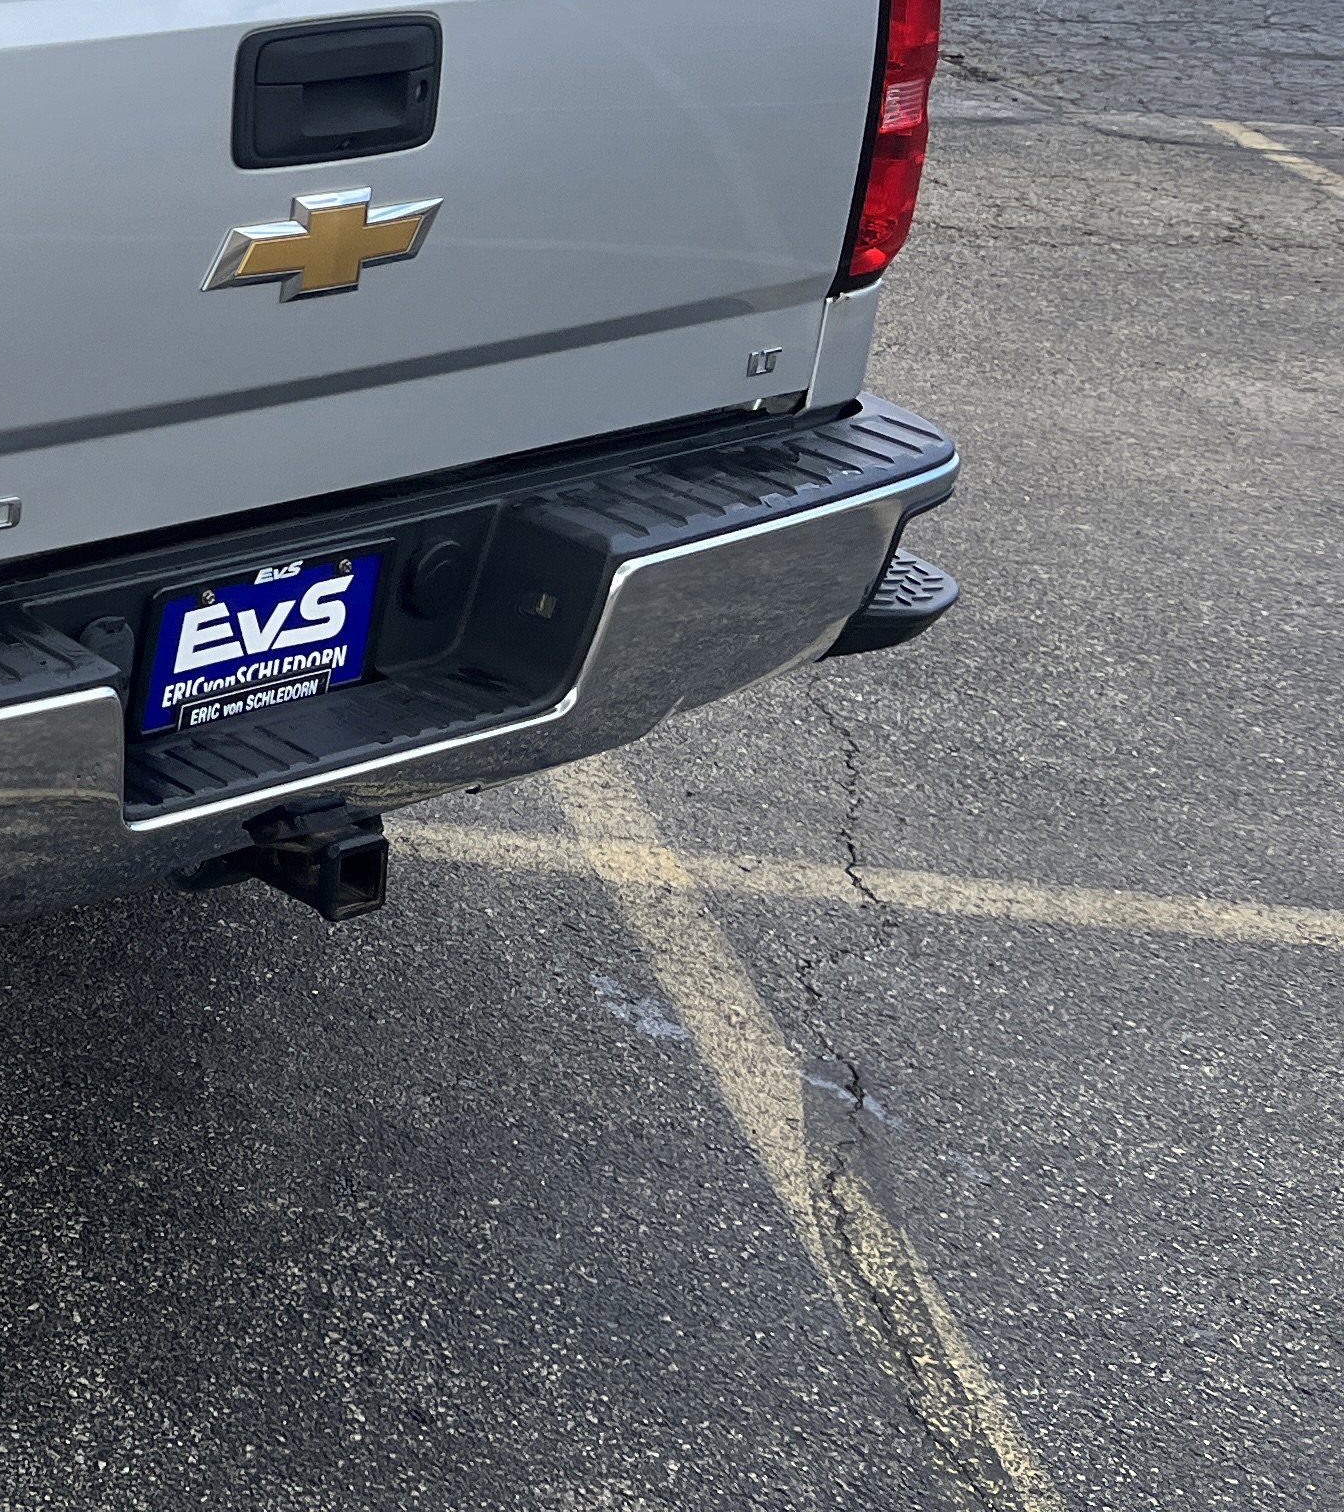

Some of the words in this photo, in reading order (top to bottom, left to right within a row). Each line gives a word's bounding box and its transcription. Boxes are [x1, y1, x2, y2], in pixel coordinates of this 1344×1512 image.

[746, 346, 783, 378] LT
[189, 703, 220, 726] ERIC
[223, 700, 244, 717] von
[245, 678, 319, 711] SCHLEDORN
